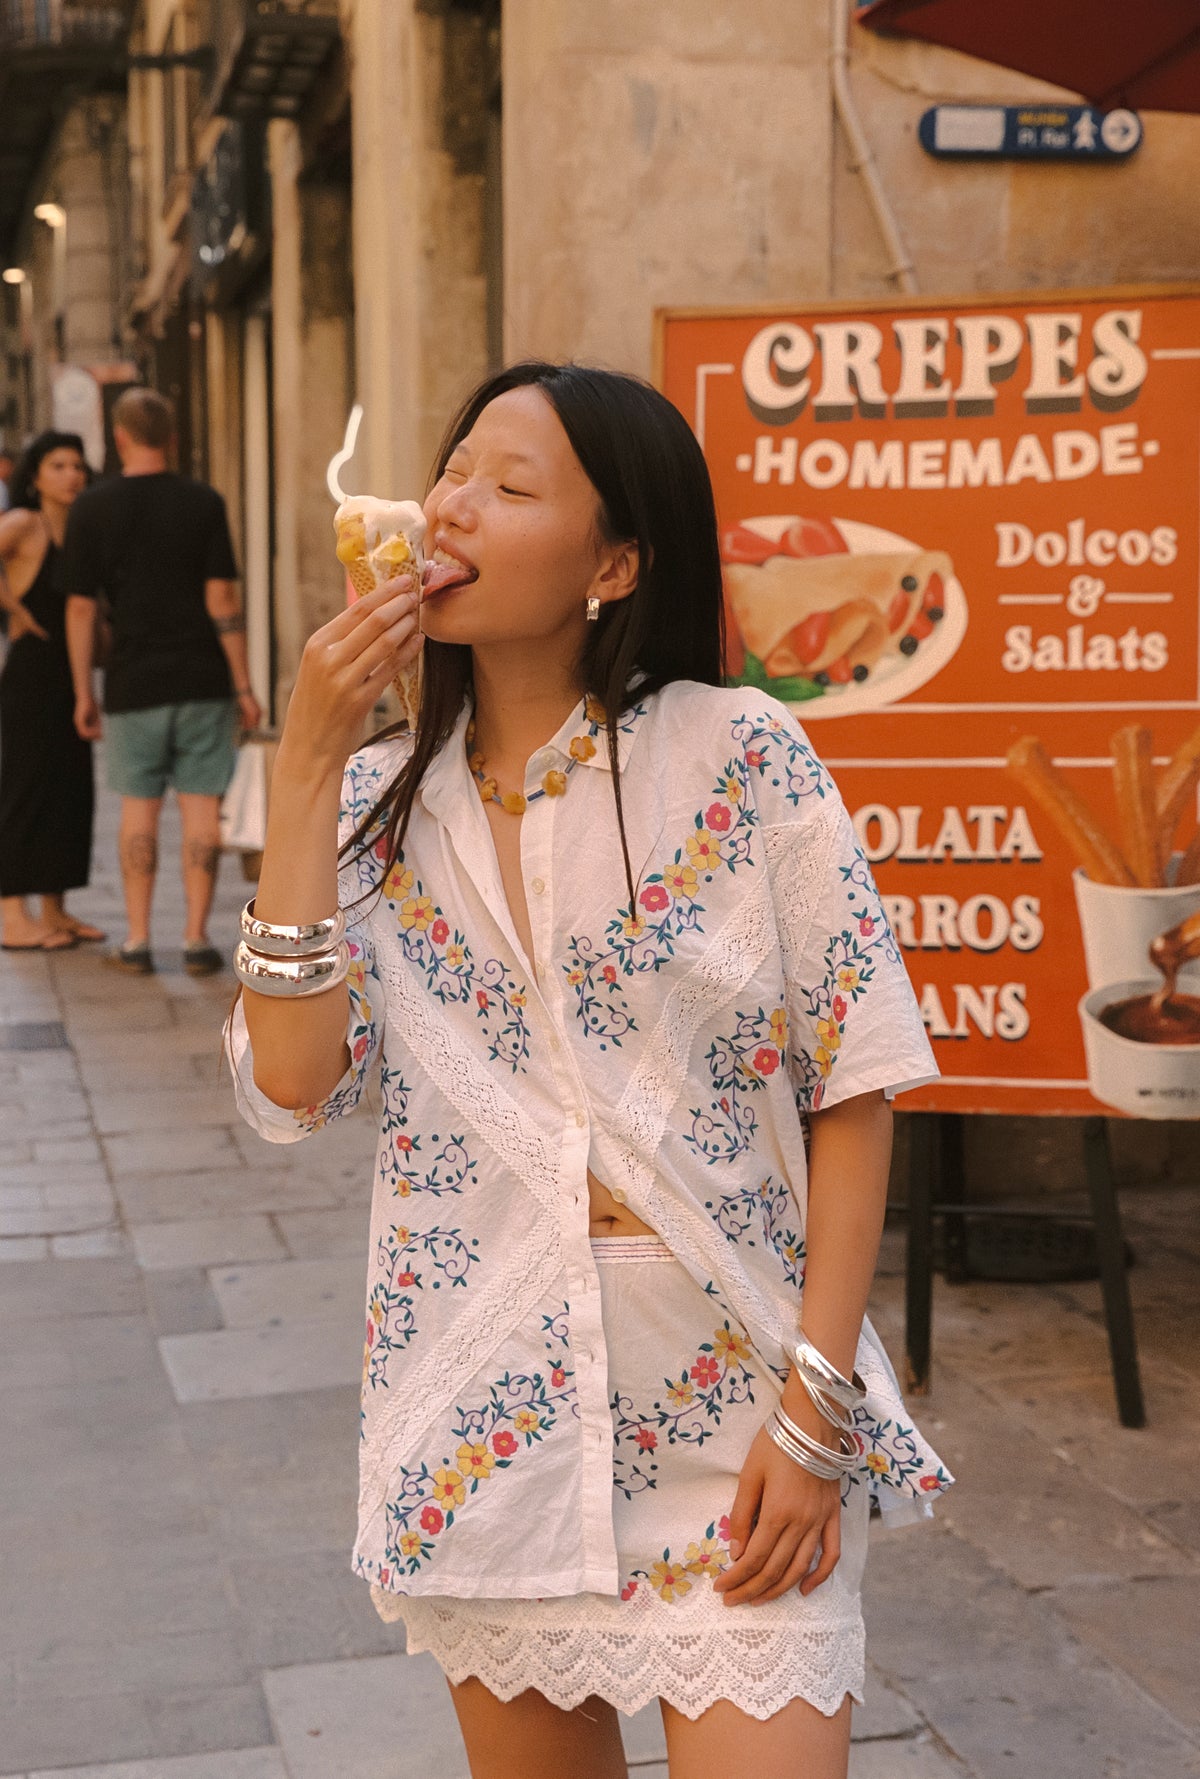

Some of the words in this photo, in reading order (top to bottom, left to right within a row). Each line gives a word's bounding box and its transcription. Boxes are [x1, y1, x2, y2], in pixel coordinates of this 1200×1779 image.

[741, 310, 1149, 411] CREPES
[1067, 575, 1105, 616] &
[1002, 625, 1168, 672] Salats
[852, 803, 1043, 863] OLATA
[880, 893, 1044, 953] RROS
